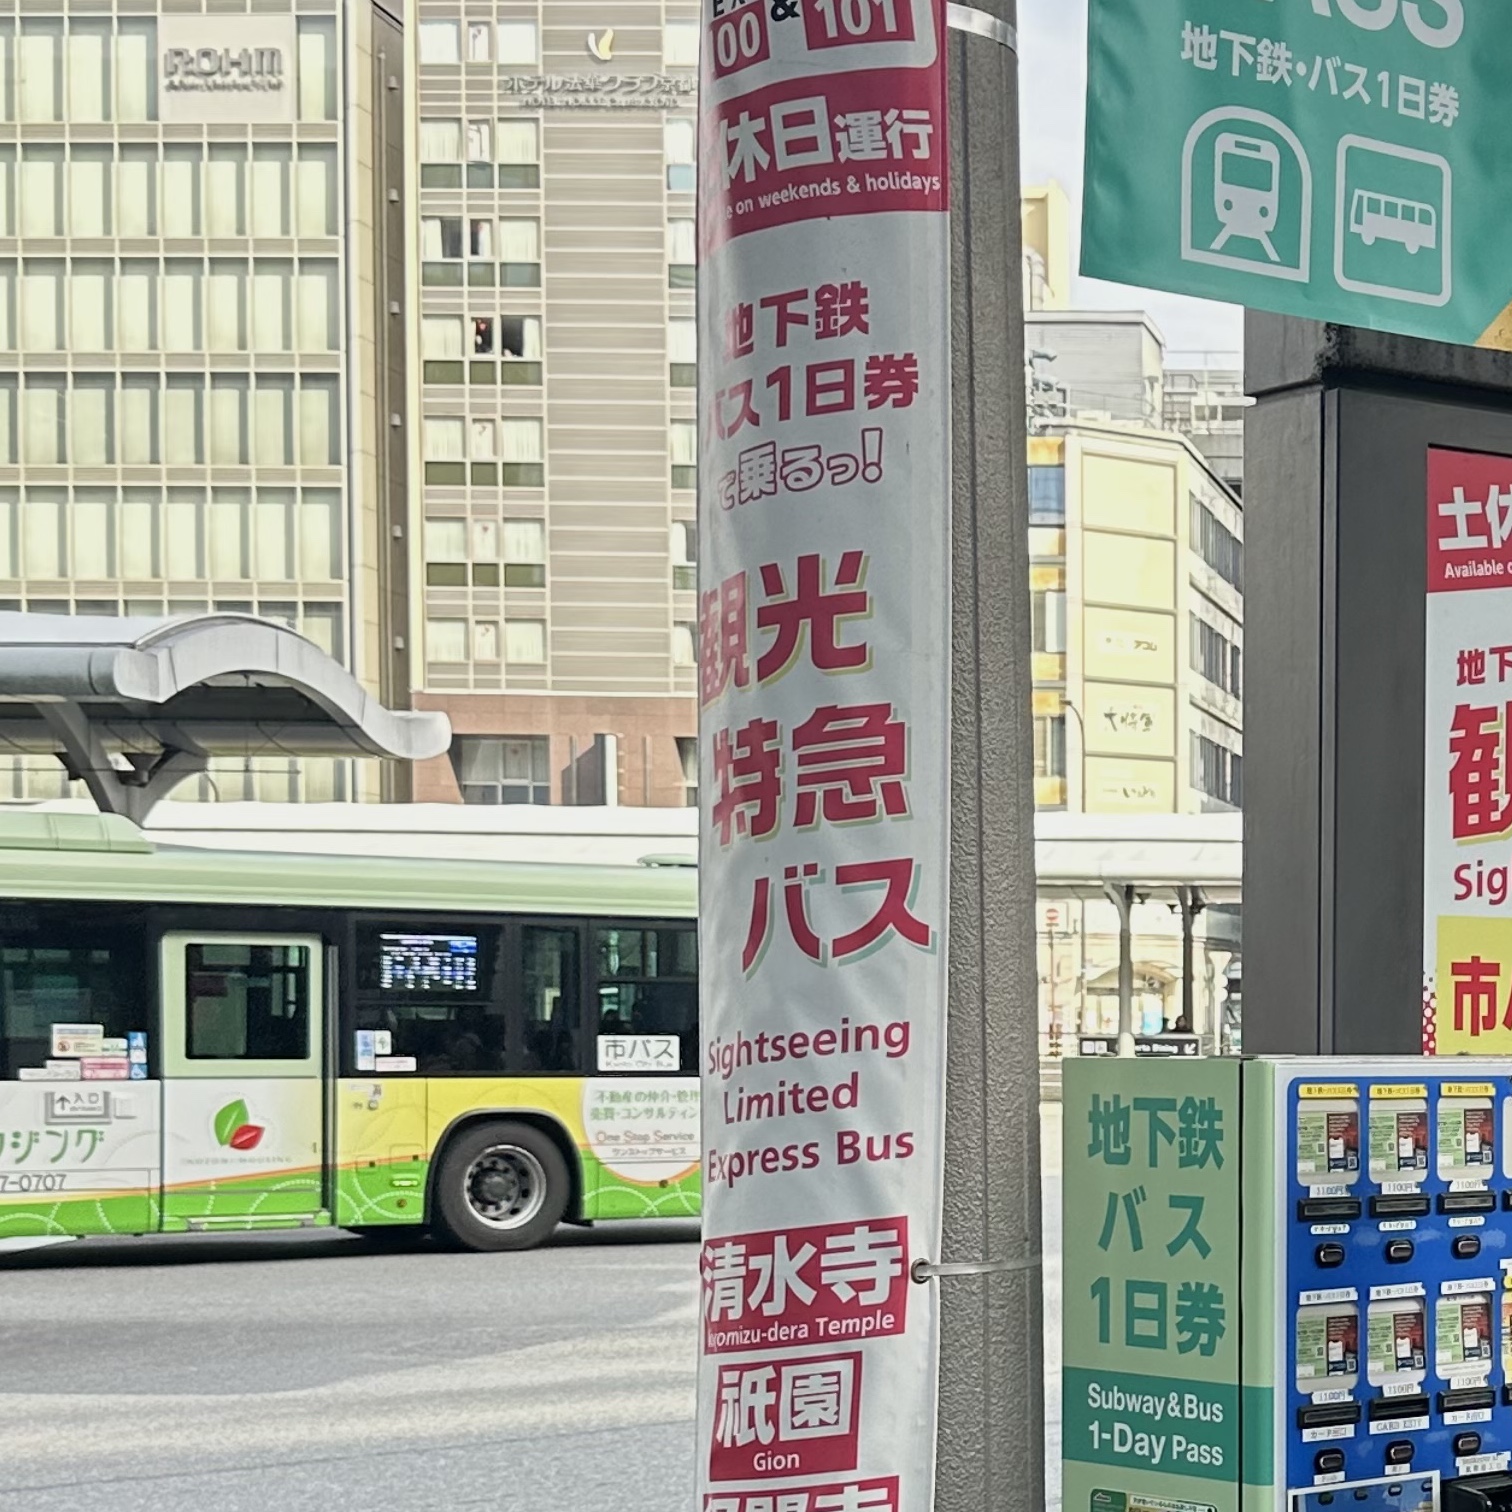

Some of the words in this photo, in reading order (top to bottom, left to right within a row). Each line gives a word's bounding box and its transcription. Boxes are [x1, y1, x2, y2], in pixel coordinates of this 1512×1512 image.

[164, 48, 283, 78] ROHM
[1181, 20, 1460, 127] 地下鉄・バス1日券
[736, 198, 754, 213] on
[758, 178, 841, 208] weekends
[866, 171, 941, 196] holidays
[724, 280, 870, 360] 地下鉄
[1445, 557, 1504, 579] Available
[700, 551, 870, 707] 観光
[712, 702, 908, 846] 特急
[741, 857, 930, 975] バス
[604, 1039, 675, 1060] 市バス
[708, 1017, 911, 1081] Sightseeing
[724, 1073, 859, 1124] Limited
[653, 1129, 695, 1142] Service
[708, 1140, 819, 1188] Express
[837, 1130, 915, 1165] Bus
[1088, 1093, 1224, 1170] 地下鉄
[1097, 1185, 1212, 1260] バス
[703, 1225, 903, 1323] 清水寺
[815, 1310, 895, 1338] Temple
[1090, 1276, 1226, 1357] 1日券
[716, 1358, 855, 1448] 祇園
[1088, 1382, 1224, 1423] Subway&Bus
[753, 1450, 800, 1471] Gion
[1088, 1420, 1166, 1464] 1-Day
[1171, 1435, 1224, 1466] Pass
